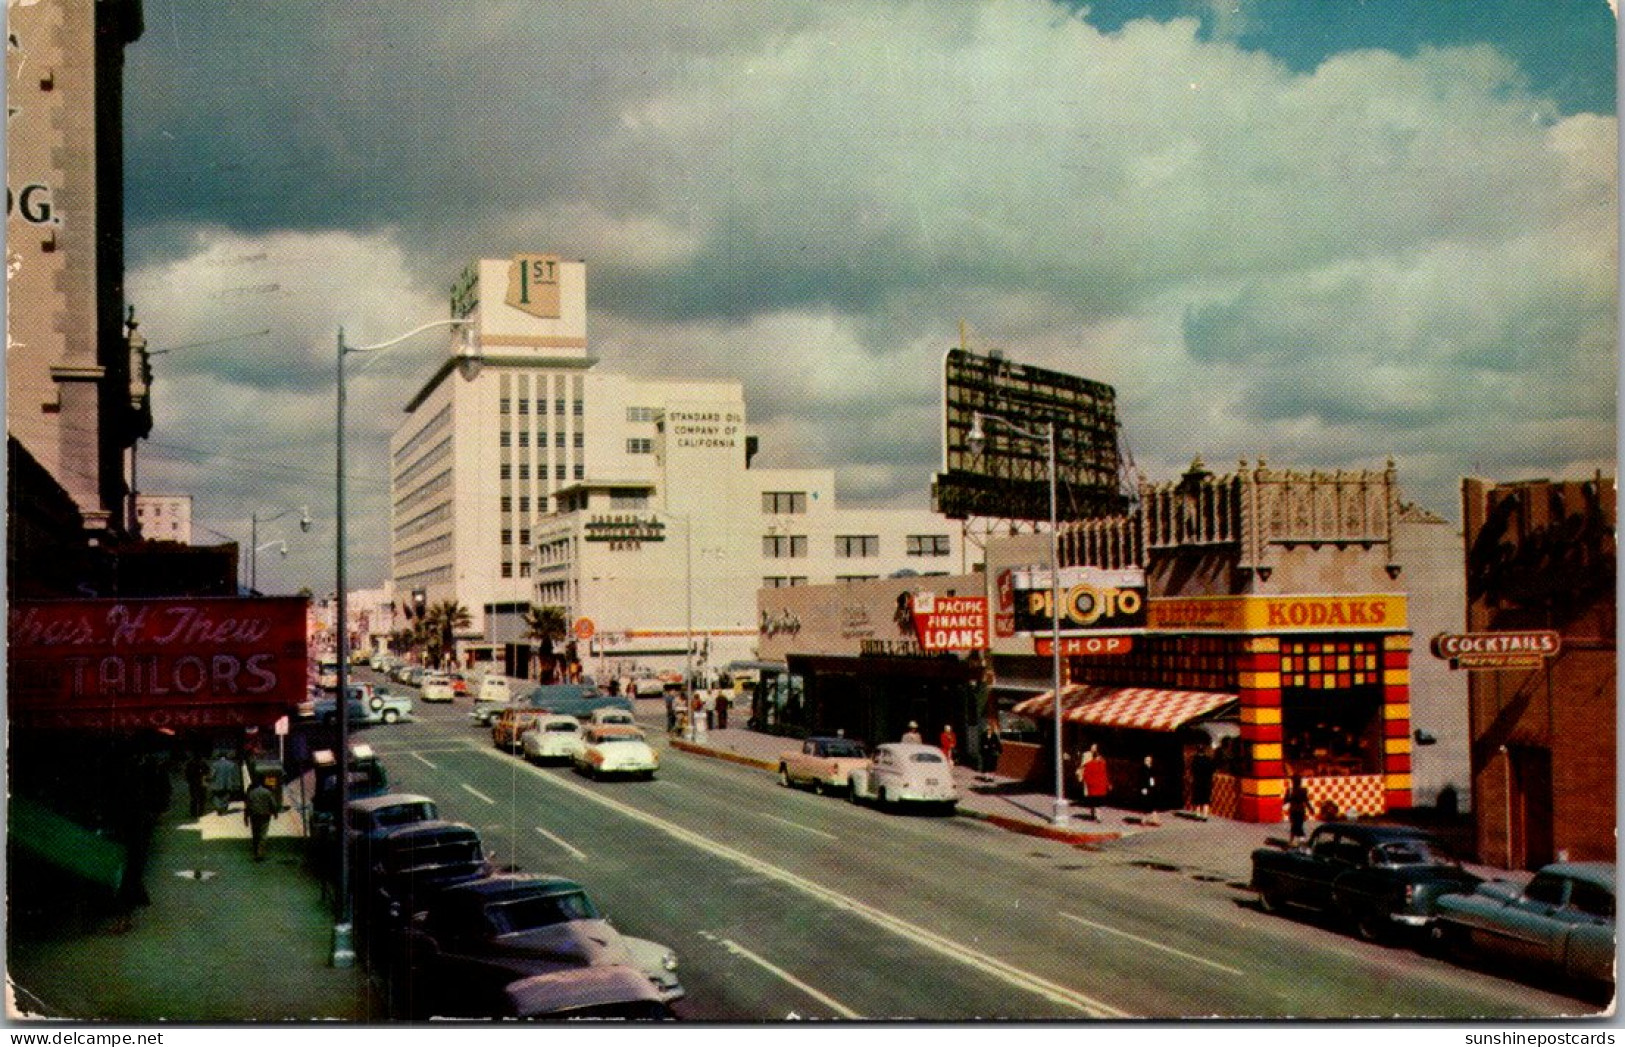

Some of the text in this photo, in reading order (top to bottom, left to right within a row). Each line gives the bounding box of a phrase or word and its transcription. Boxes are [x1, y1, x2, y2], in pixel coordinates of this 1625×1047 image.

[7, 184, 60, 223] G.
[670, 412, 741, 422] STANDARD OIL
[674, 425, 737, 434] COMPANY OF
[678, 438, 735, 447] CALIFORNIA
[609, 539, 641, 551] BANK
[937, 600, 983, 613] PACIFIC
[1029, 582, 1141, 625] PHOTO
[928, 615, 984, 628] FINANCE
[1266, 601, 1386, 626] KODAKS
[152, 606, 272, 647] Thew
[924, 630, 985, 648] LOANS
[1446, 634, 1553, 652] COCKTAILS
[63, 653, 278, 697] TAILORS
